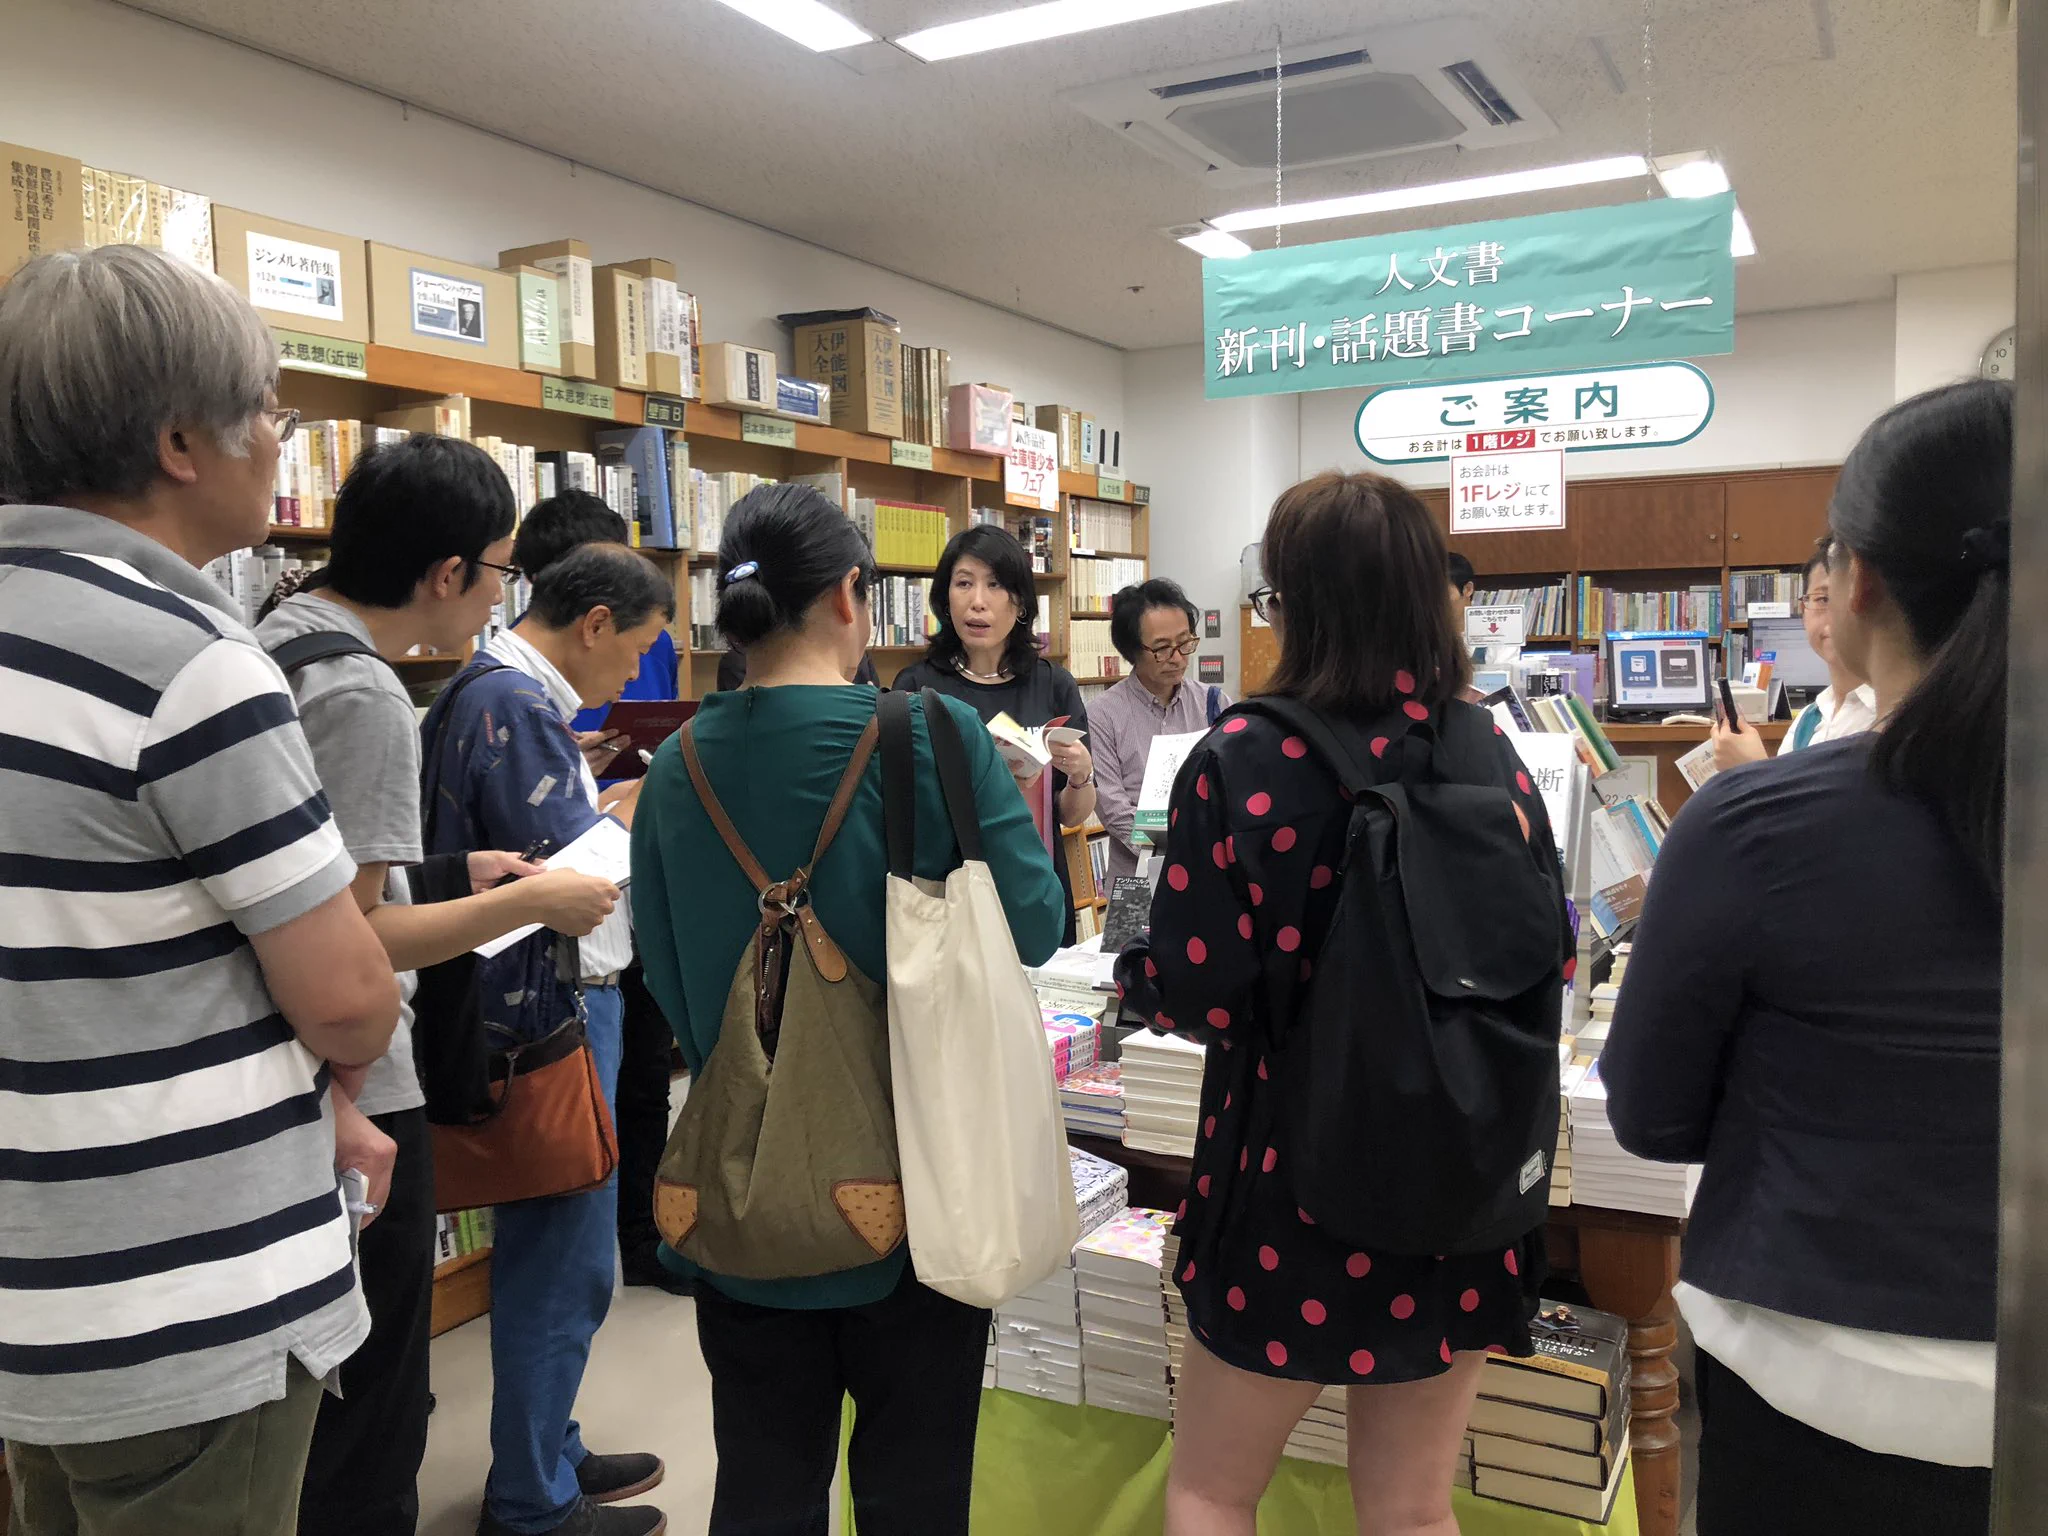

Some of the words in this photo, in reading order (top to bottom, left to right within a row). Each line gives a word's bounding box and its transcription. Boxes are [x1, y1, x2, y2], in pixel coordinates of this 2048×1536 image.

[25, 164, 40, 255] 朝鮮侵略関係史
[255, 248, 334, 277] ジンメル著作集
[1375, 240, 1505, 296] 人文書
[416, 276, 480, 297] ショーペンハウアー
[1215, 285, 1715, 377] 新刊・話題書コーナー
[281, 341, 364, 369] 本思想(近世)
[1995, 348, 2007, 358] 10
[1991, 364, 1999, 374] 9
[544, 386, 612, 411] 日本思想(近世)
[1440, 381, 1618, 426] ご案内
[673, 406, 682, 422] B
[1408, 438, 1462, 453] お会計は
[1471, 432, 1531, 450] 1階レジ
[1540, 425, 1659, 442] でお願い致します。
[1021, 471, 1045, 494] フェア
[1460, 463, 1510, 479] お会計は
[1460, 481, 1521, 503] 1Fレジ
[1525, 482, 1551, 497] にて
[1460, 503, 1555, 520] お願い致します。
